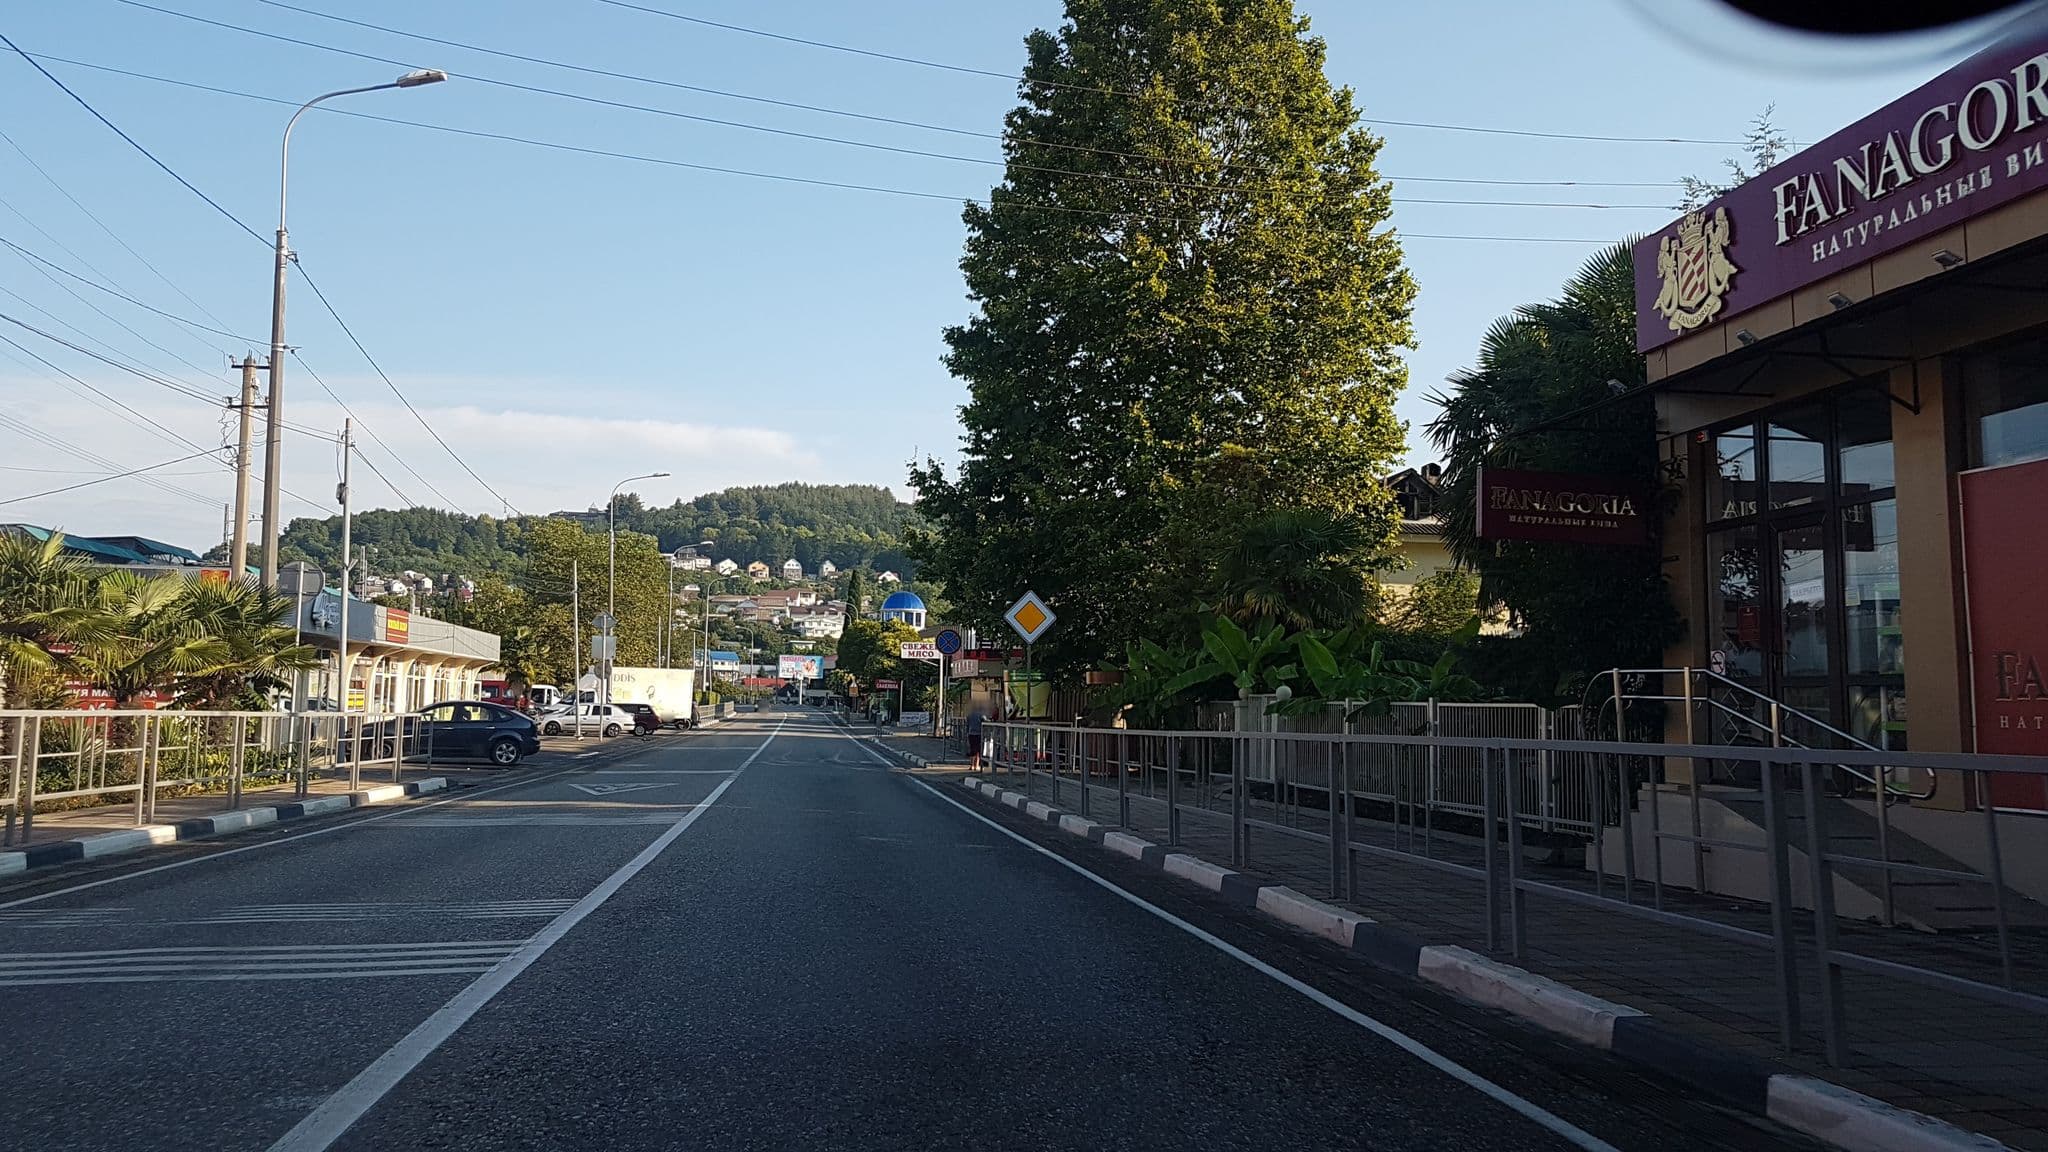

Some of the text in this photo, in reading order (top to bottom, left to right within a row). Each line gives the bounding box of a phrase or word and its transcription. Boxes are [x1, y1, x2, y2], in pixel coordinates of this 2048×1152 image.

[1811, 164, 1992, 263] НАТУРАЛЬНЫЕ
[1490, 486, 1639, 516] FANAGORIA
[902, 643, 938, 651] СВЕЖЕ
[908, 650, 935, 658] МЯСО
[1999, 714, 2044, 729] НАТ
